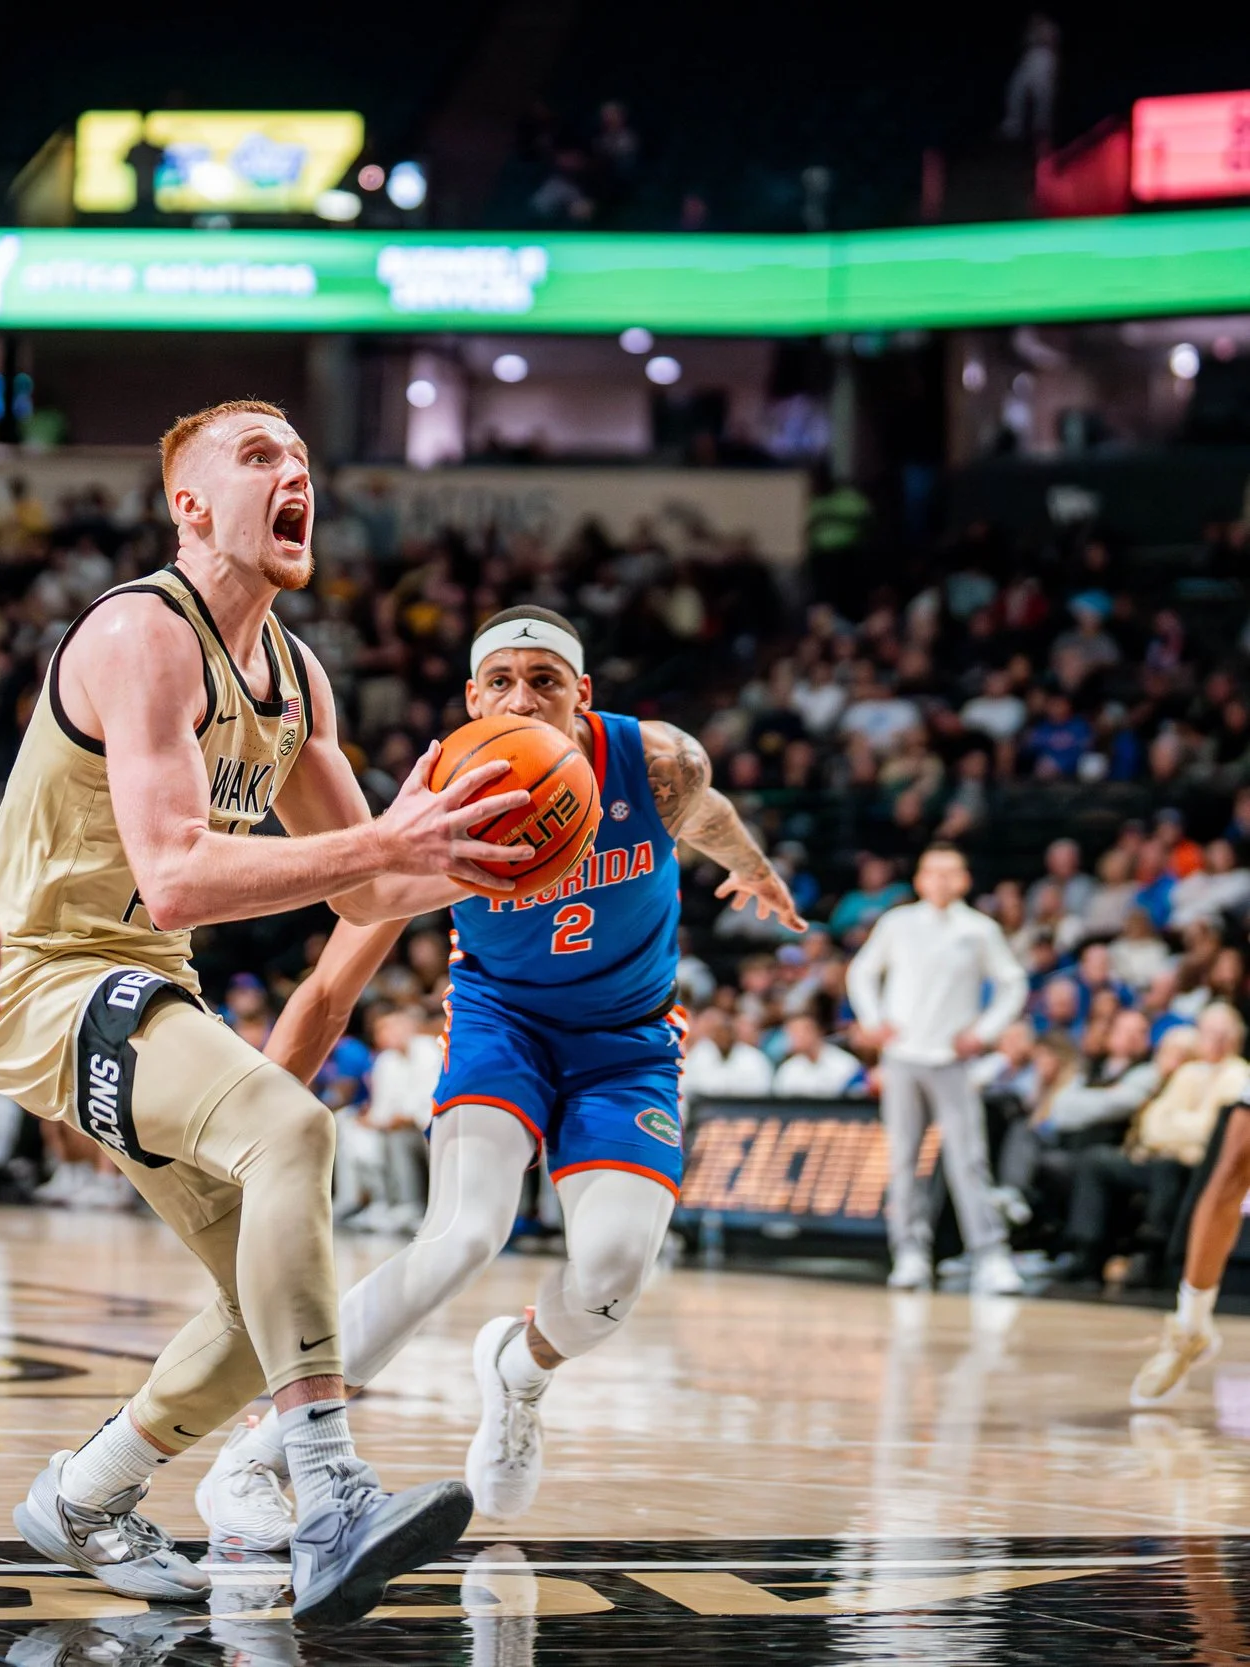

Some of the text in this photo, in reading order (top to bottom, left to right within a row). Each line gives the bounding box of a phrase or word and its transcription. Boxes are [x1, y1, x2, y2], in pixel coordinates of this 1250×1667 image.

[209, 755, 278, 815] WAK
[487, 840, 655, 913] RIDA
[550, 902, 595, 955] 2
